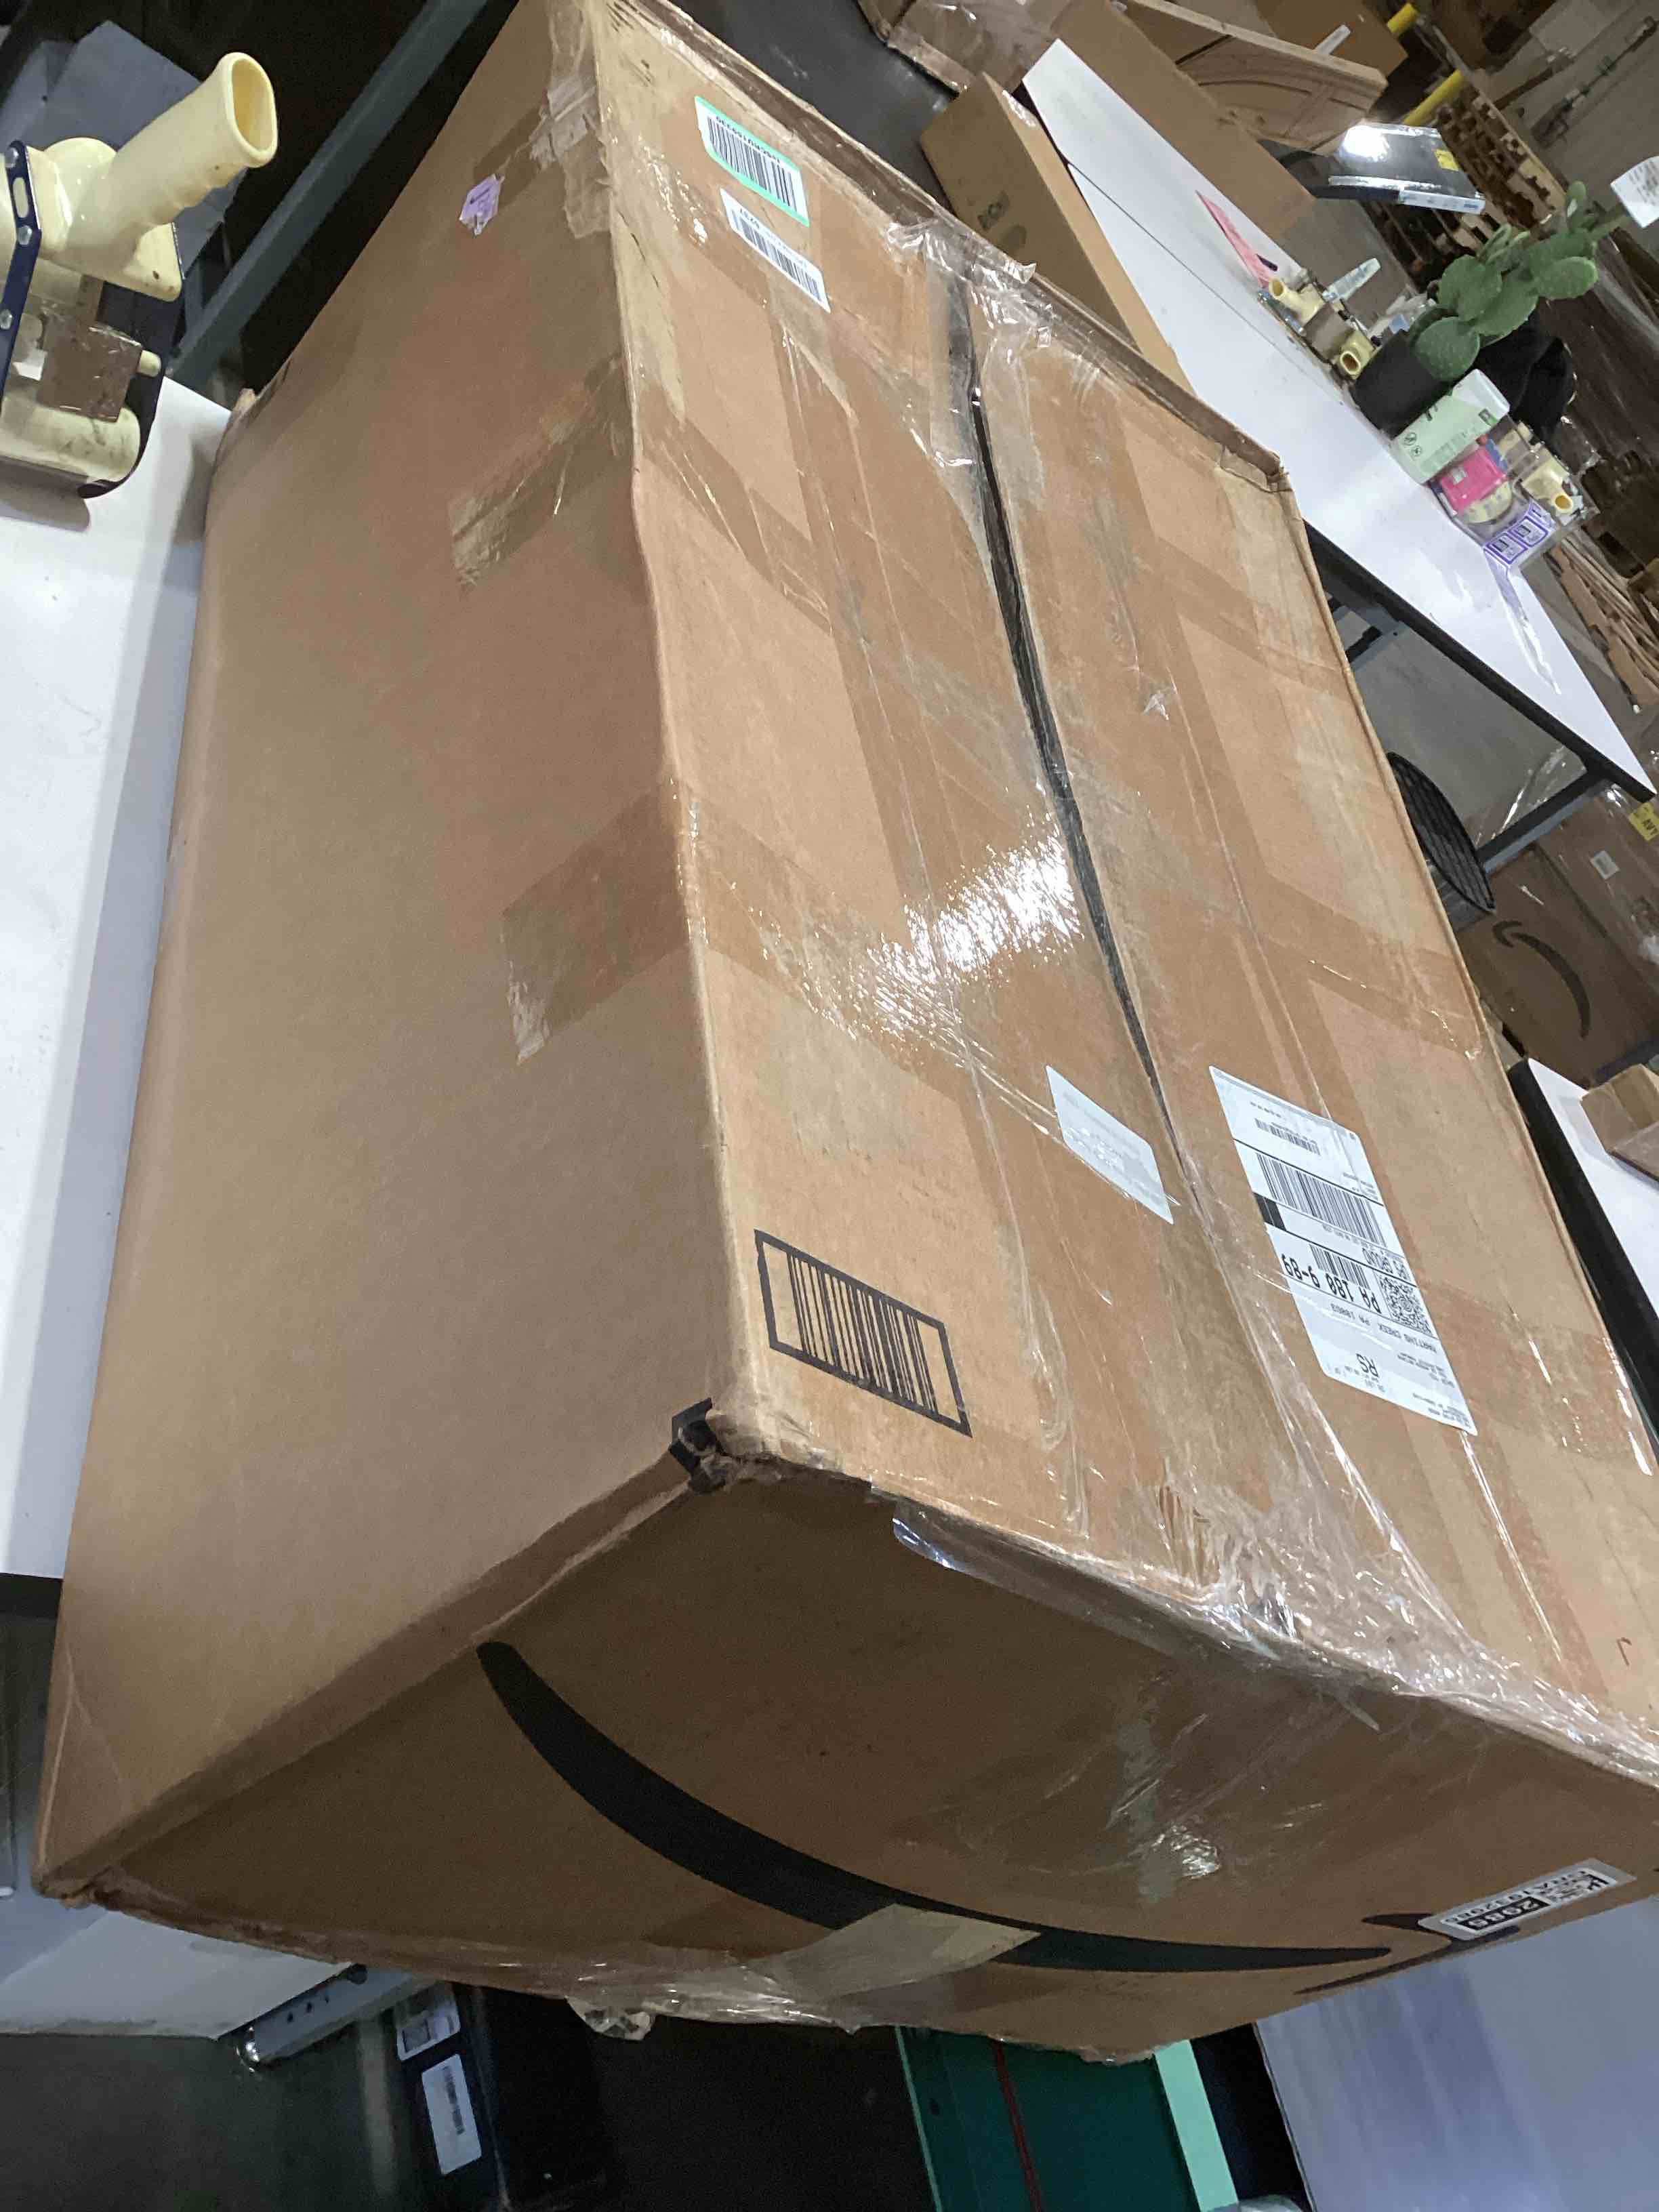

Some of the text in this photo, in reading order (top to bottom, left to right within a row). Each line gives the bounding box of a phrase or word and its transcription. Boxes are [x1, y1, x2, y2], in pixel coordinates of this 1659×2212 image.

[1281, 1253, 1382, 1315] PA 180 9-89
[1355, 1353, 1380, 1378] RS
